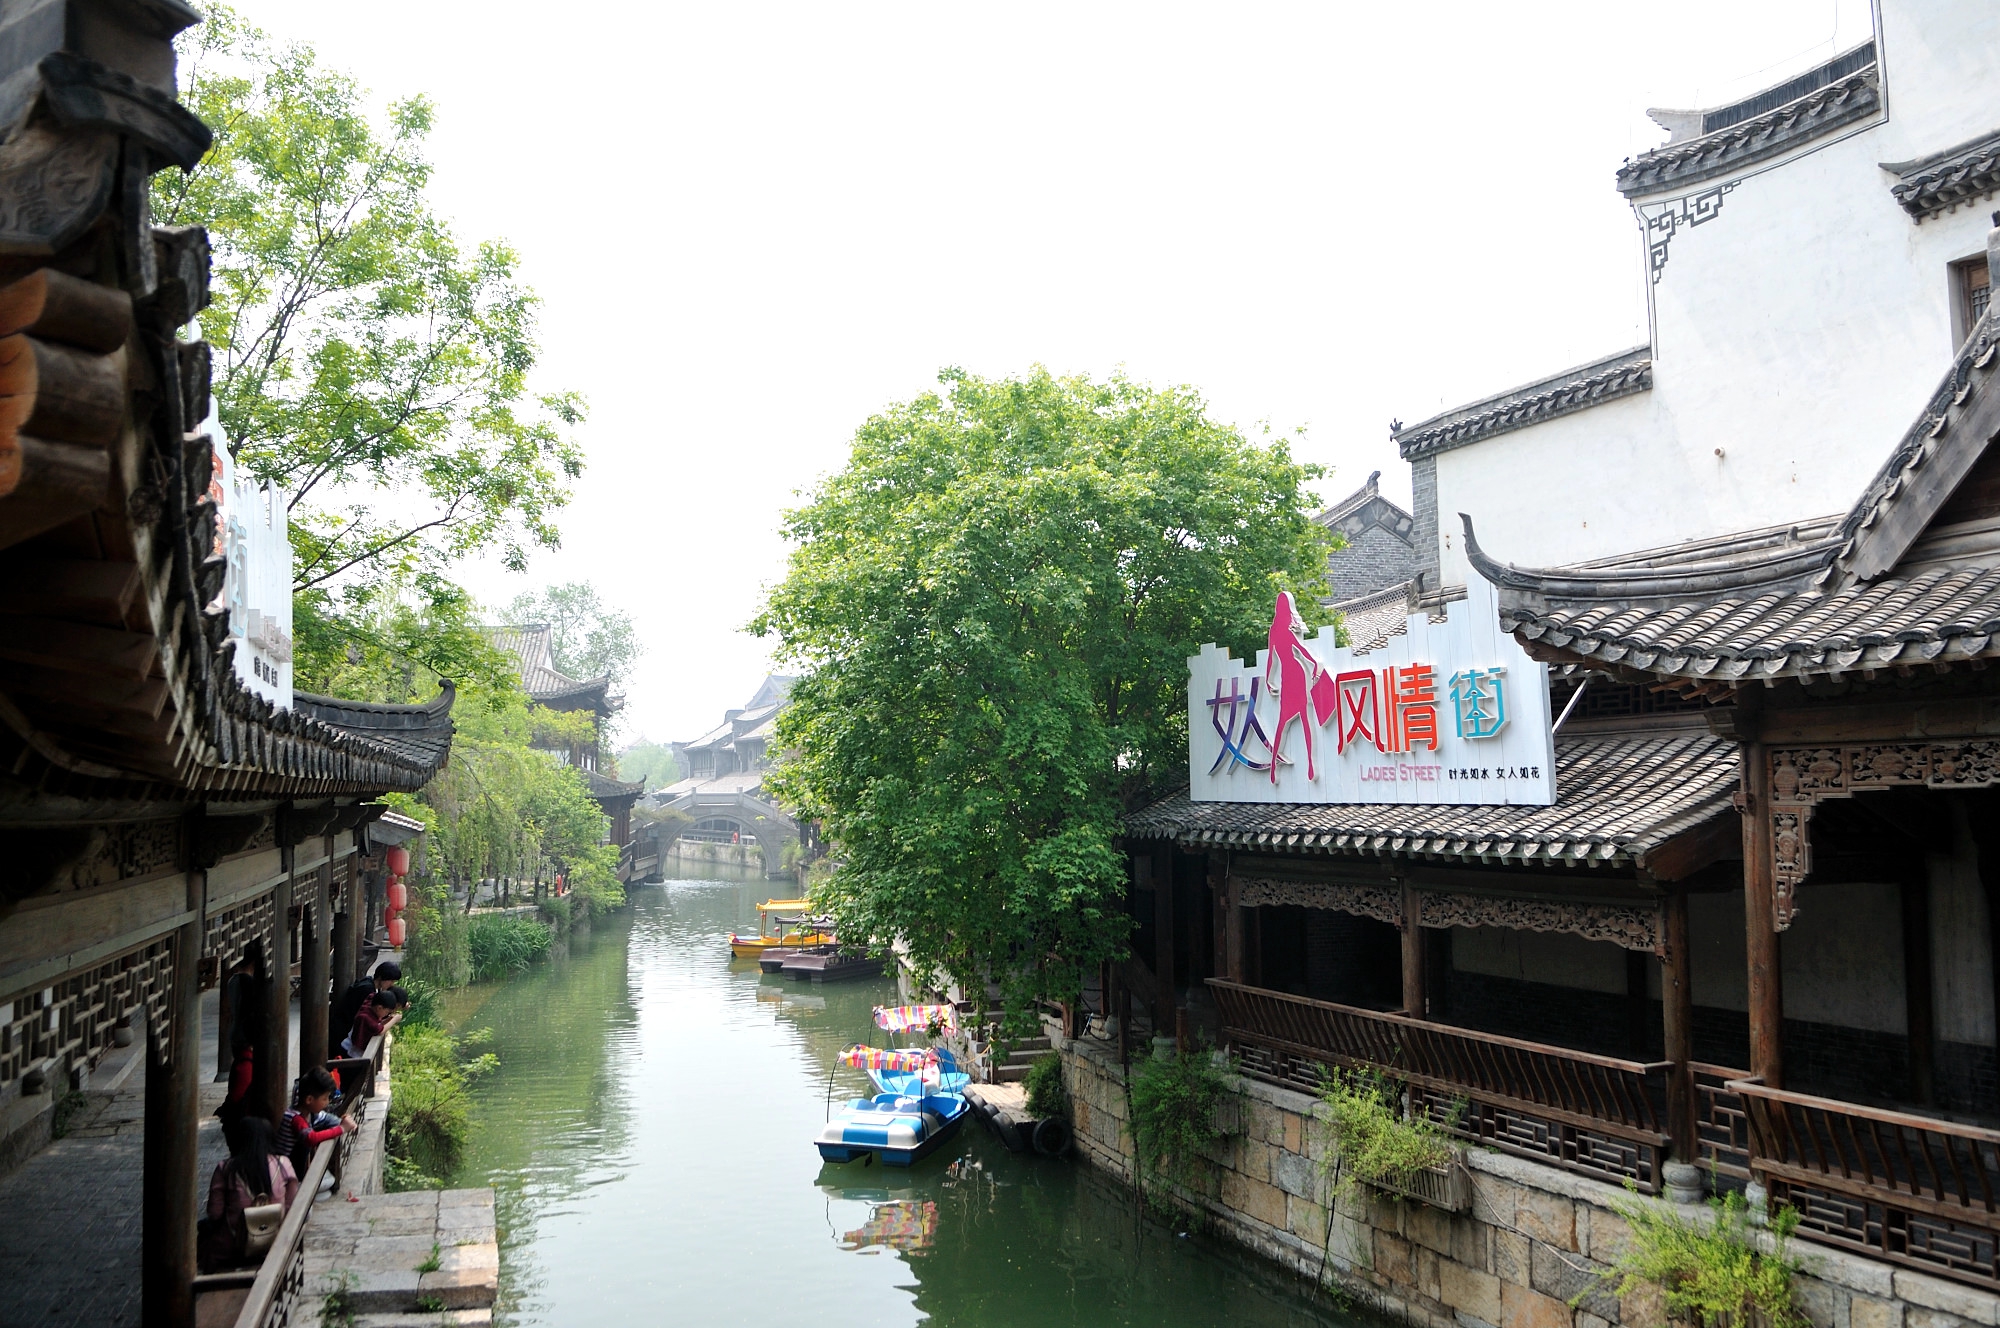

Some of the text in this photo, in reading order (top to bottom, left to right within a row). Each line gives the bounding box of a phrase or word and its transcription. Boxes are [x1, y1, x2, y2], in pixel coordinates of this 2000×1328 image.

[1206, 663, 1504, 775] 女人风情街
[1399, 763, 1442, 781] STREET
[1448, 766, 1540, 780] 时光如水 女人如花
